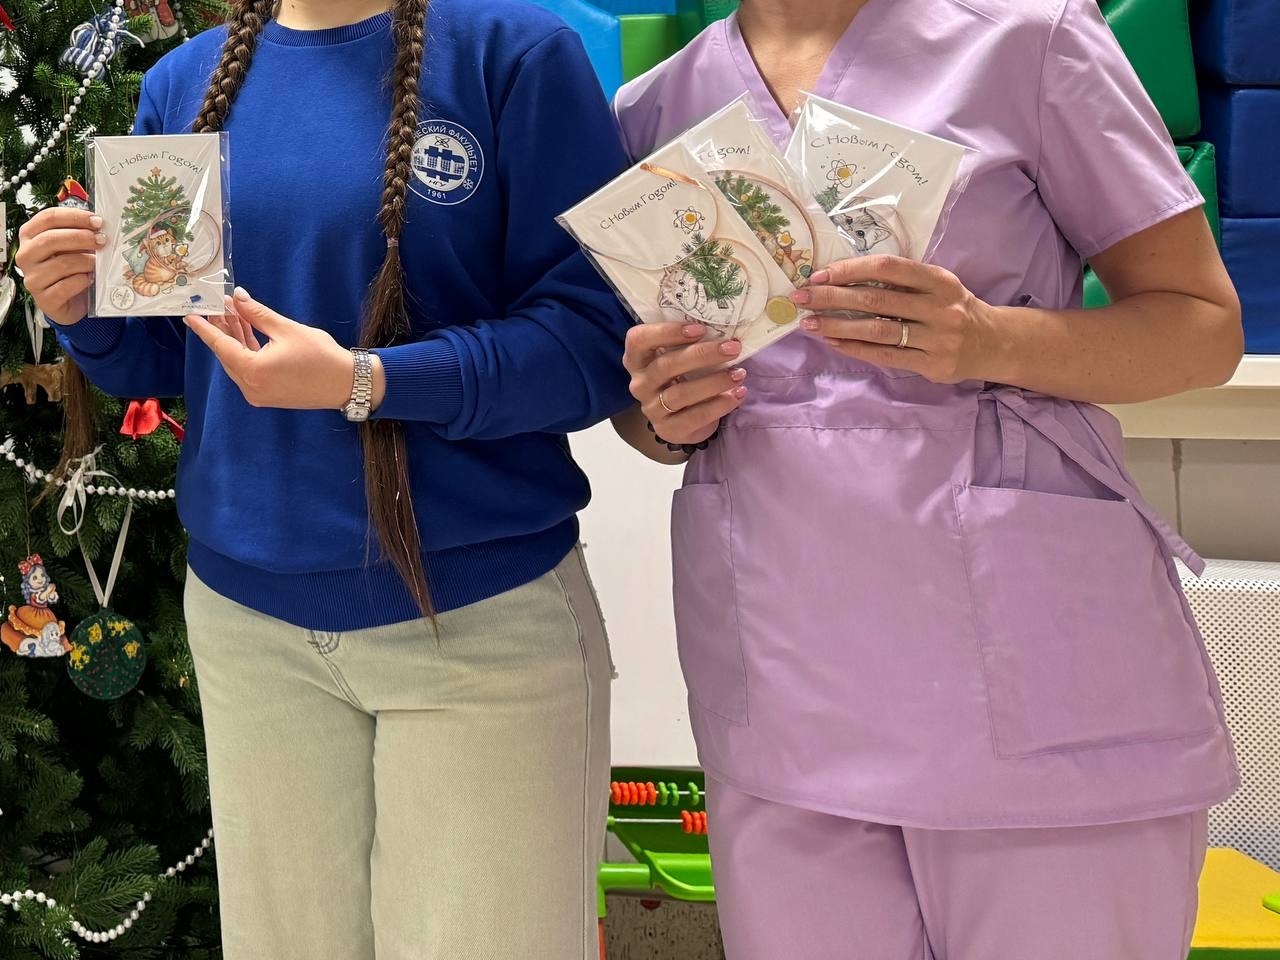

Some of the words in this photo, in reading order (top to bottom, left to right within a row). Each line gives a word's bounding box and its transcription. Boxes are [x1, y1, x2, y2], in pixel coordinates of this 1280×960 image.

[810, 137, 825, 148] С
[448, 129, 478, 172] ФАКУЛЬТЕТ
[427, 188, 447, 200] 1961
